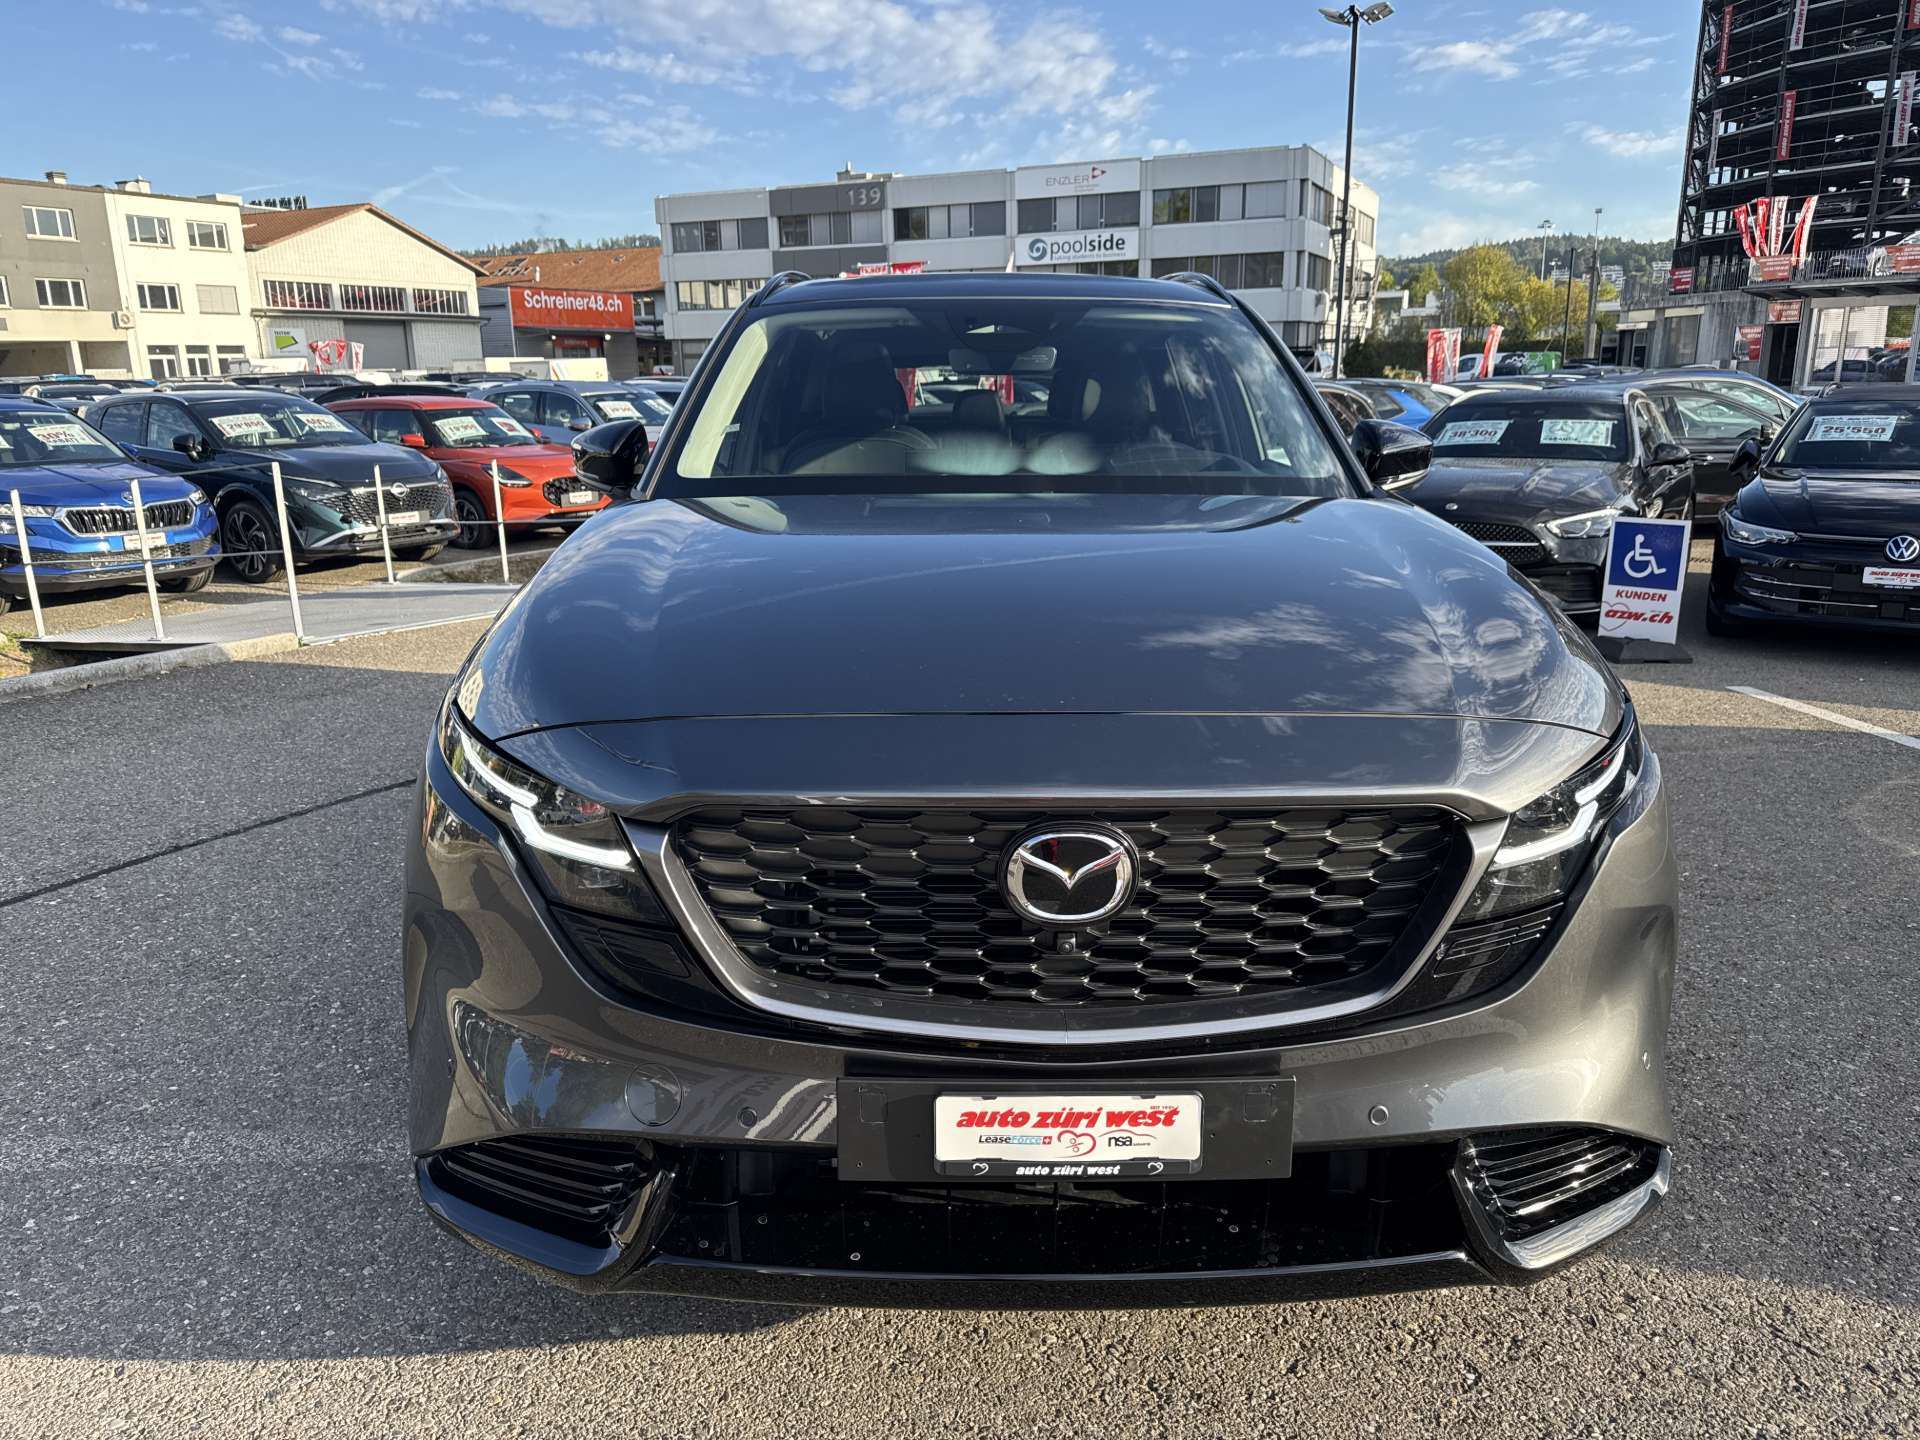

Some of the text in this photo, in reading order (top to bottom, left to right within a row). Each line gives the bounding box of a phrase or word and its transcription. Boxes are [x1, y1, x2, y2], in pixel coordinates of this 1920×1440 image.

[1046, 174, 1089, 186] ENZLER
[848, 187, 881, 206] 139
[1050, 233, 1126, 261] poolside
[524, 289, 623, 312] Schreiner48.ch
[1823, 425, 1887, 434] 25'550
[1616, 589, 1668, 602] KUNDEN
[1605, 609, 1674, 624] azw.ch
[956, 1106, 1180, 1128] auto züri west
[979, 1135, 1041, 1145] LeaseForce
[1108, 1136, 1133, 1147] nsa
[1015, 1165, 1120, 1175] auto züri west
